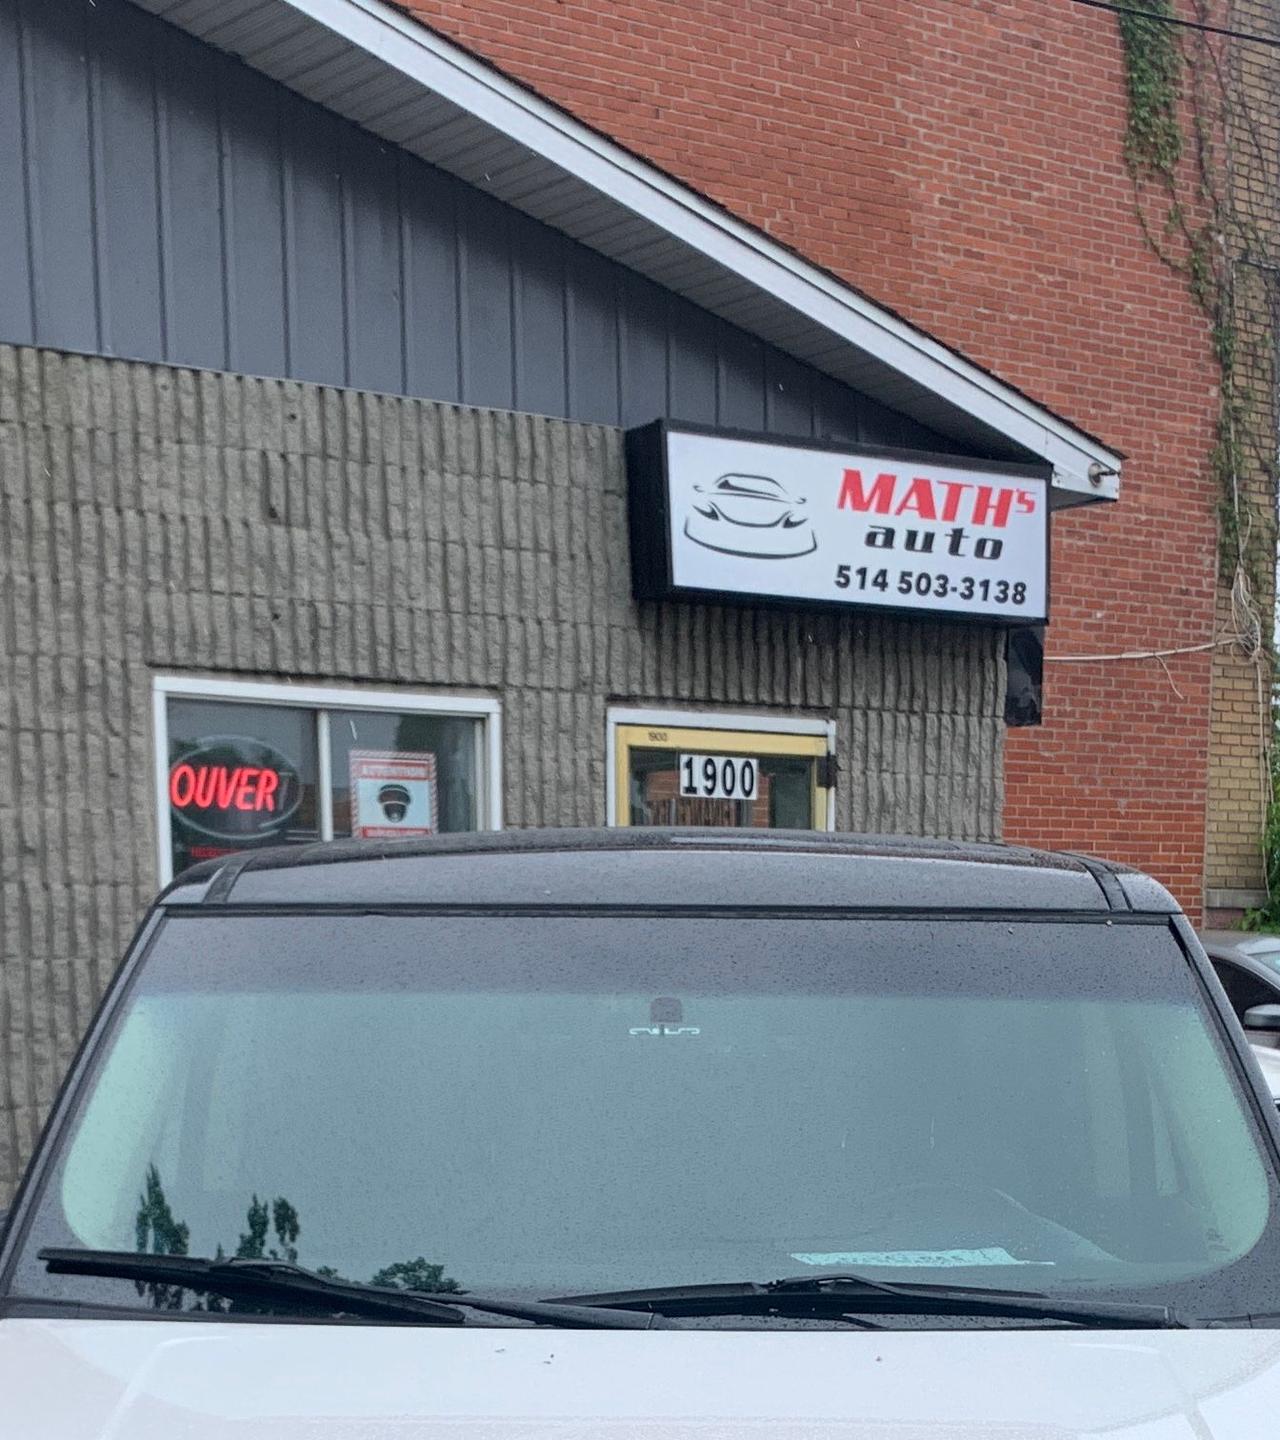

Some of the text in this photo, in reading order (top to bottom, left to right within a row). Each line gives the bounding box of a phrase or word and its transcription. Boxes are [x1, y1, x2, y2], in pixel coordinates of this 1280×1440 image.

[864, 525, 1004, 560] auto
[834, 564, 1027, 605] 514 503-3138
[683, 756, 755, 798] 1900
